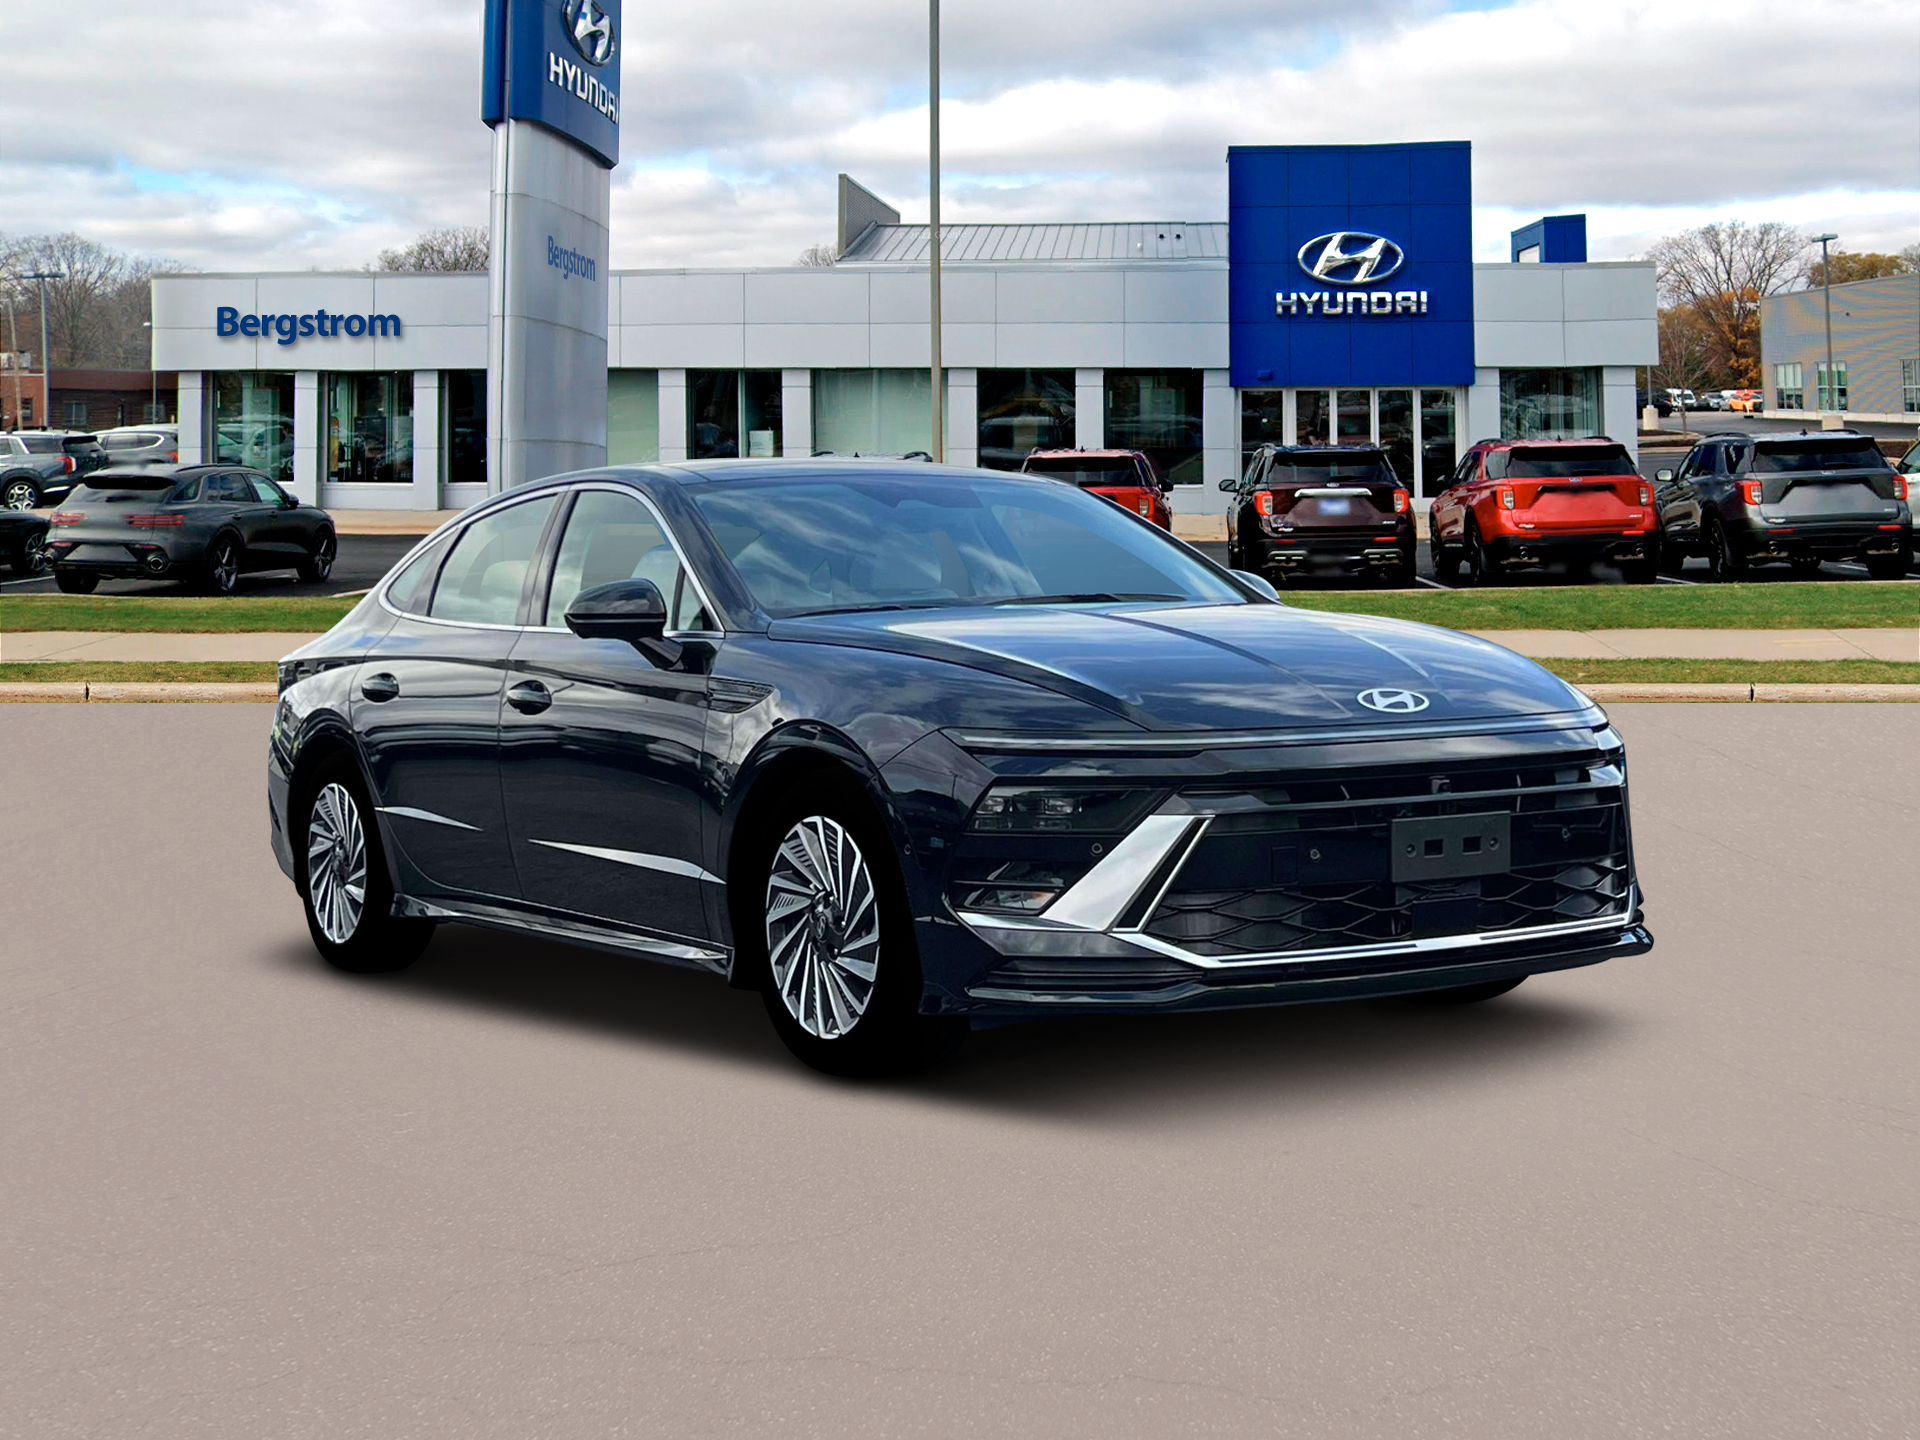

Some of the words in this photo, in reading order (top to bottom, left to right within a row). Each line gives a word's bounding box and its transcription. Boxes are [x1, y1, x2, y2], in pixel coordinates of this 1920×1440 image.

[548, 52, 619, 124] HYUNDAI
[547, 235, 596, 282] Bergstrom
[1275, 290, 1428, 316] HYUNDAI
[216, 306, 402, 346] Bergstrom
